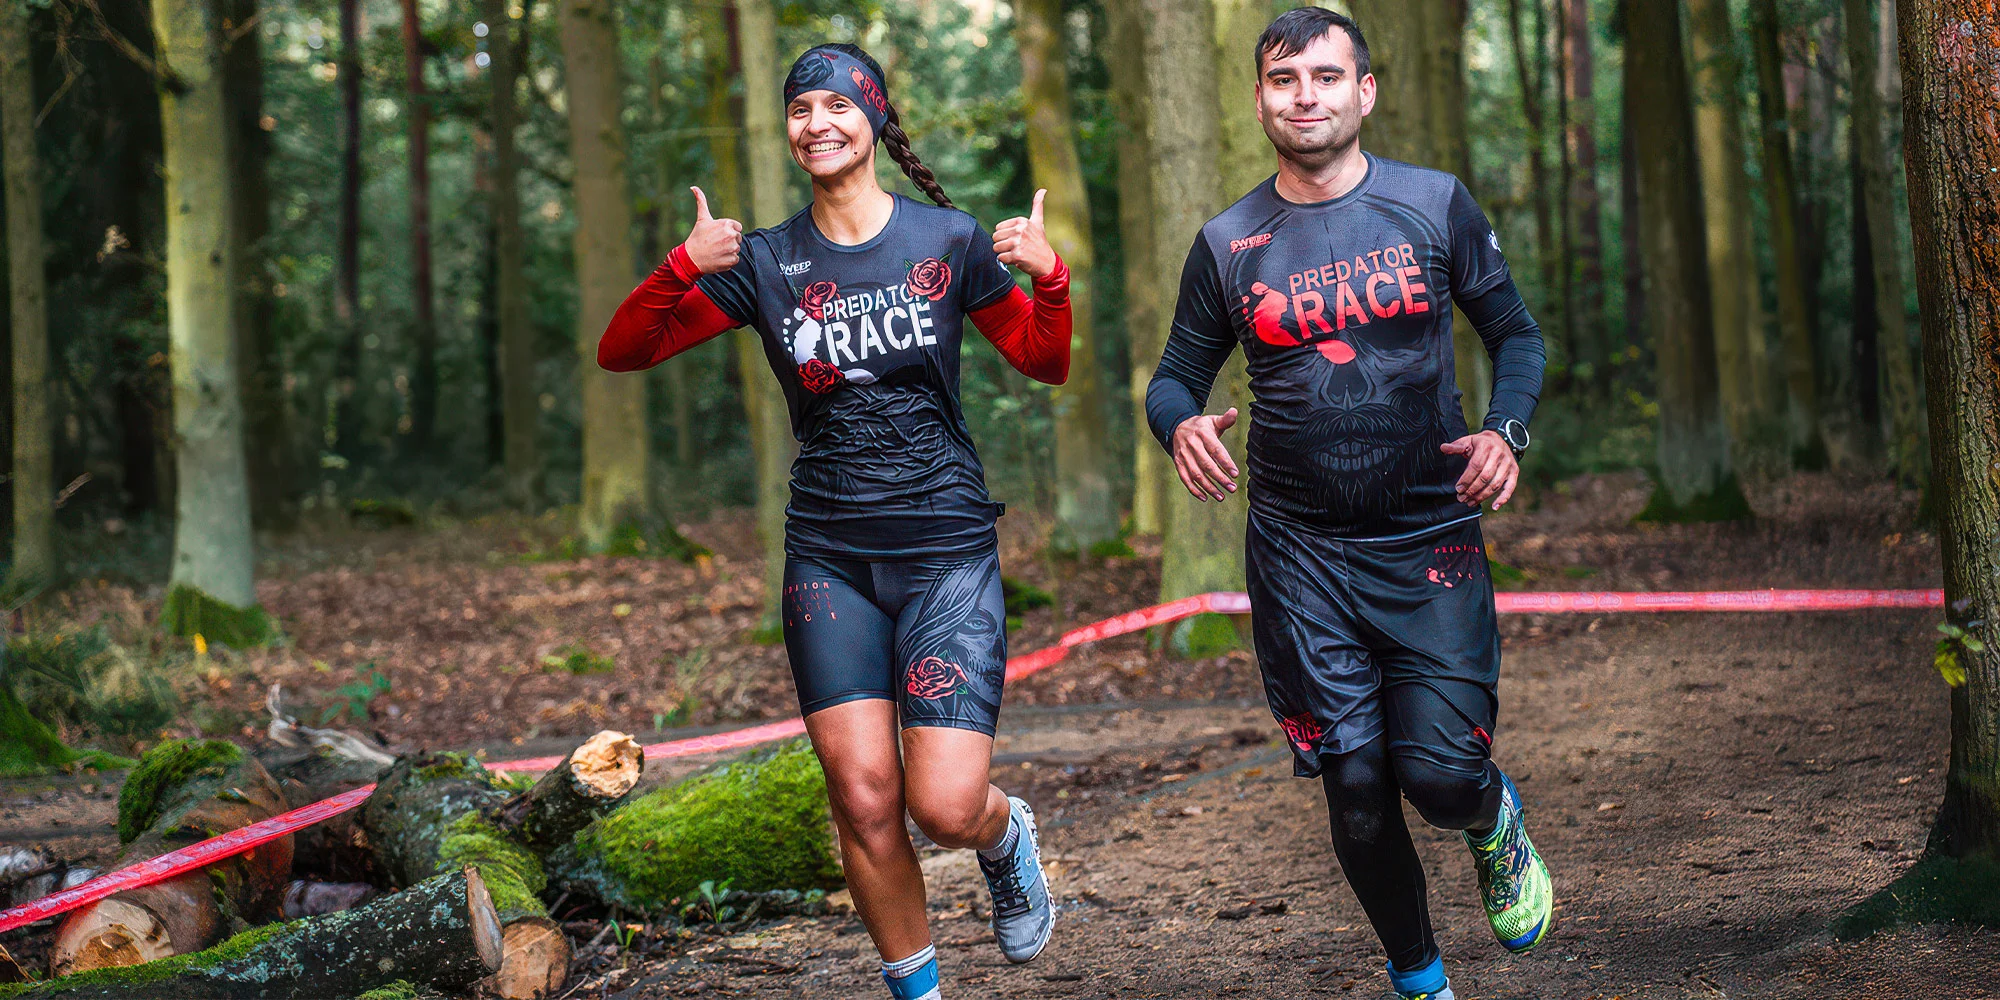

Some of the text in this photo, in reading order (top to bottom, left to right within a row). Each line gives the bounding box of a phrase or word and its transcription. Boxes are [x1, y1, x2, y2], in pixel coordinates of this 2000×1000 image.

[1289, 243, 1418, 295] PREDATOR
[822, 283, 920, 324] PREDATO
[1292, 265, 1430, 339] RACE
[824, 301, 938, 367] RACE
